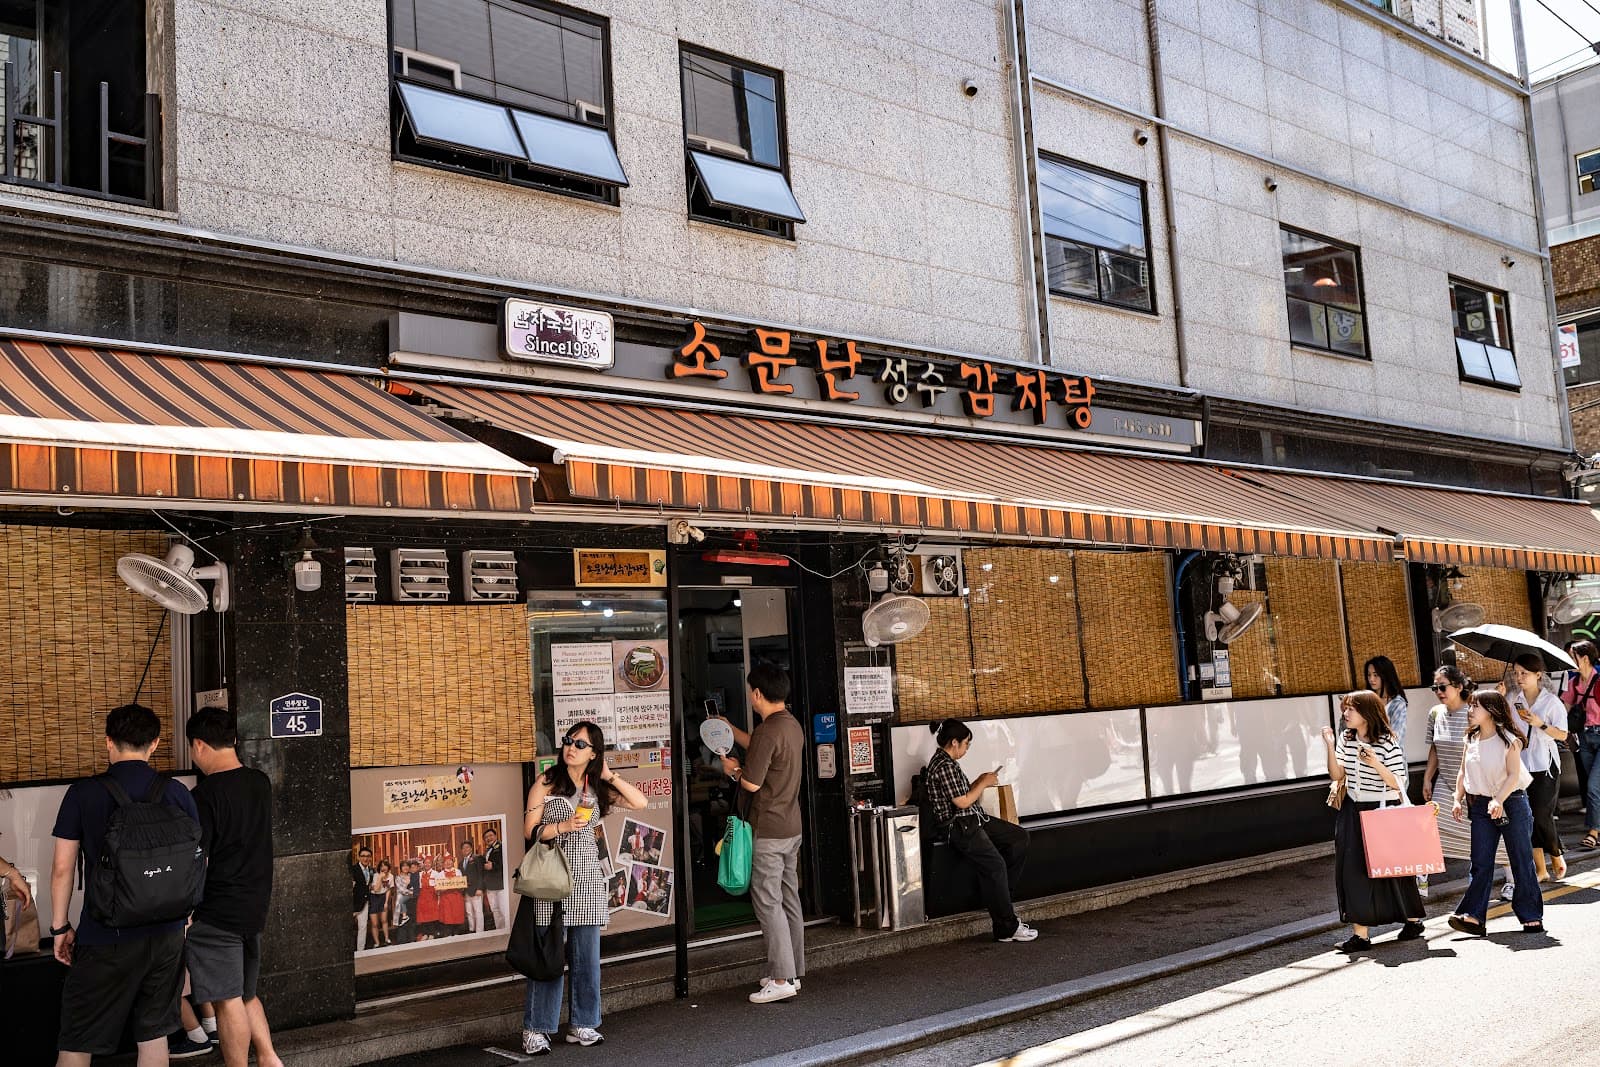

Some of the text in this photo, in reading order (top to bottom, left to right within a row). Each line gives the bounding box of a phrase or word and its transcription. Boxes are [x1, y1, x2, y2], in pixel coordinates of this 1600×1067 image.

[525, 333, 600, 360] Since1983
[670, 320, 1098, 430] 소문난 성수 감자탕
[286, 715, 307, 732] 45
